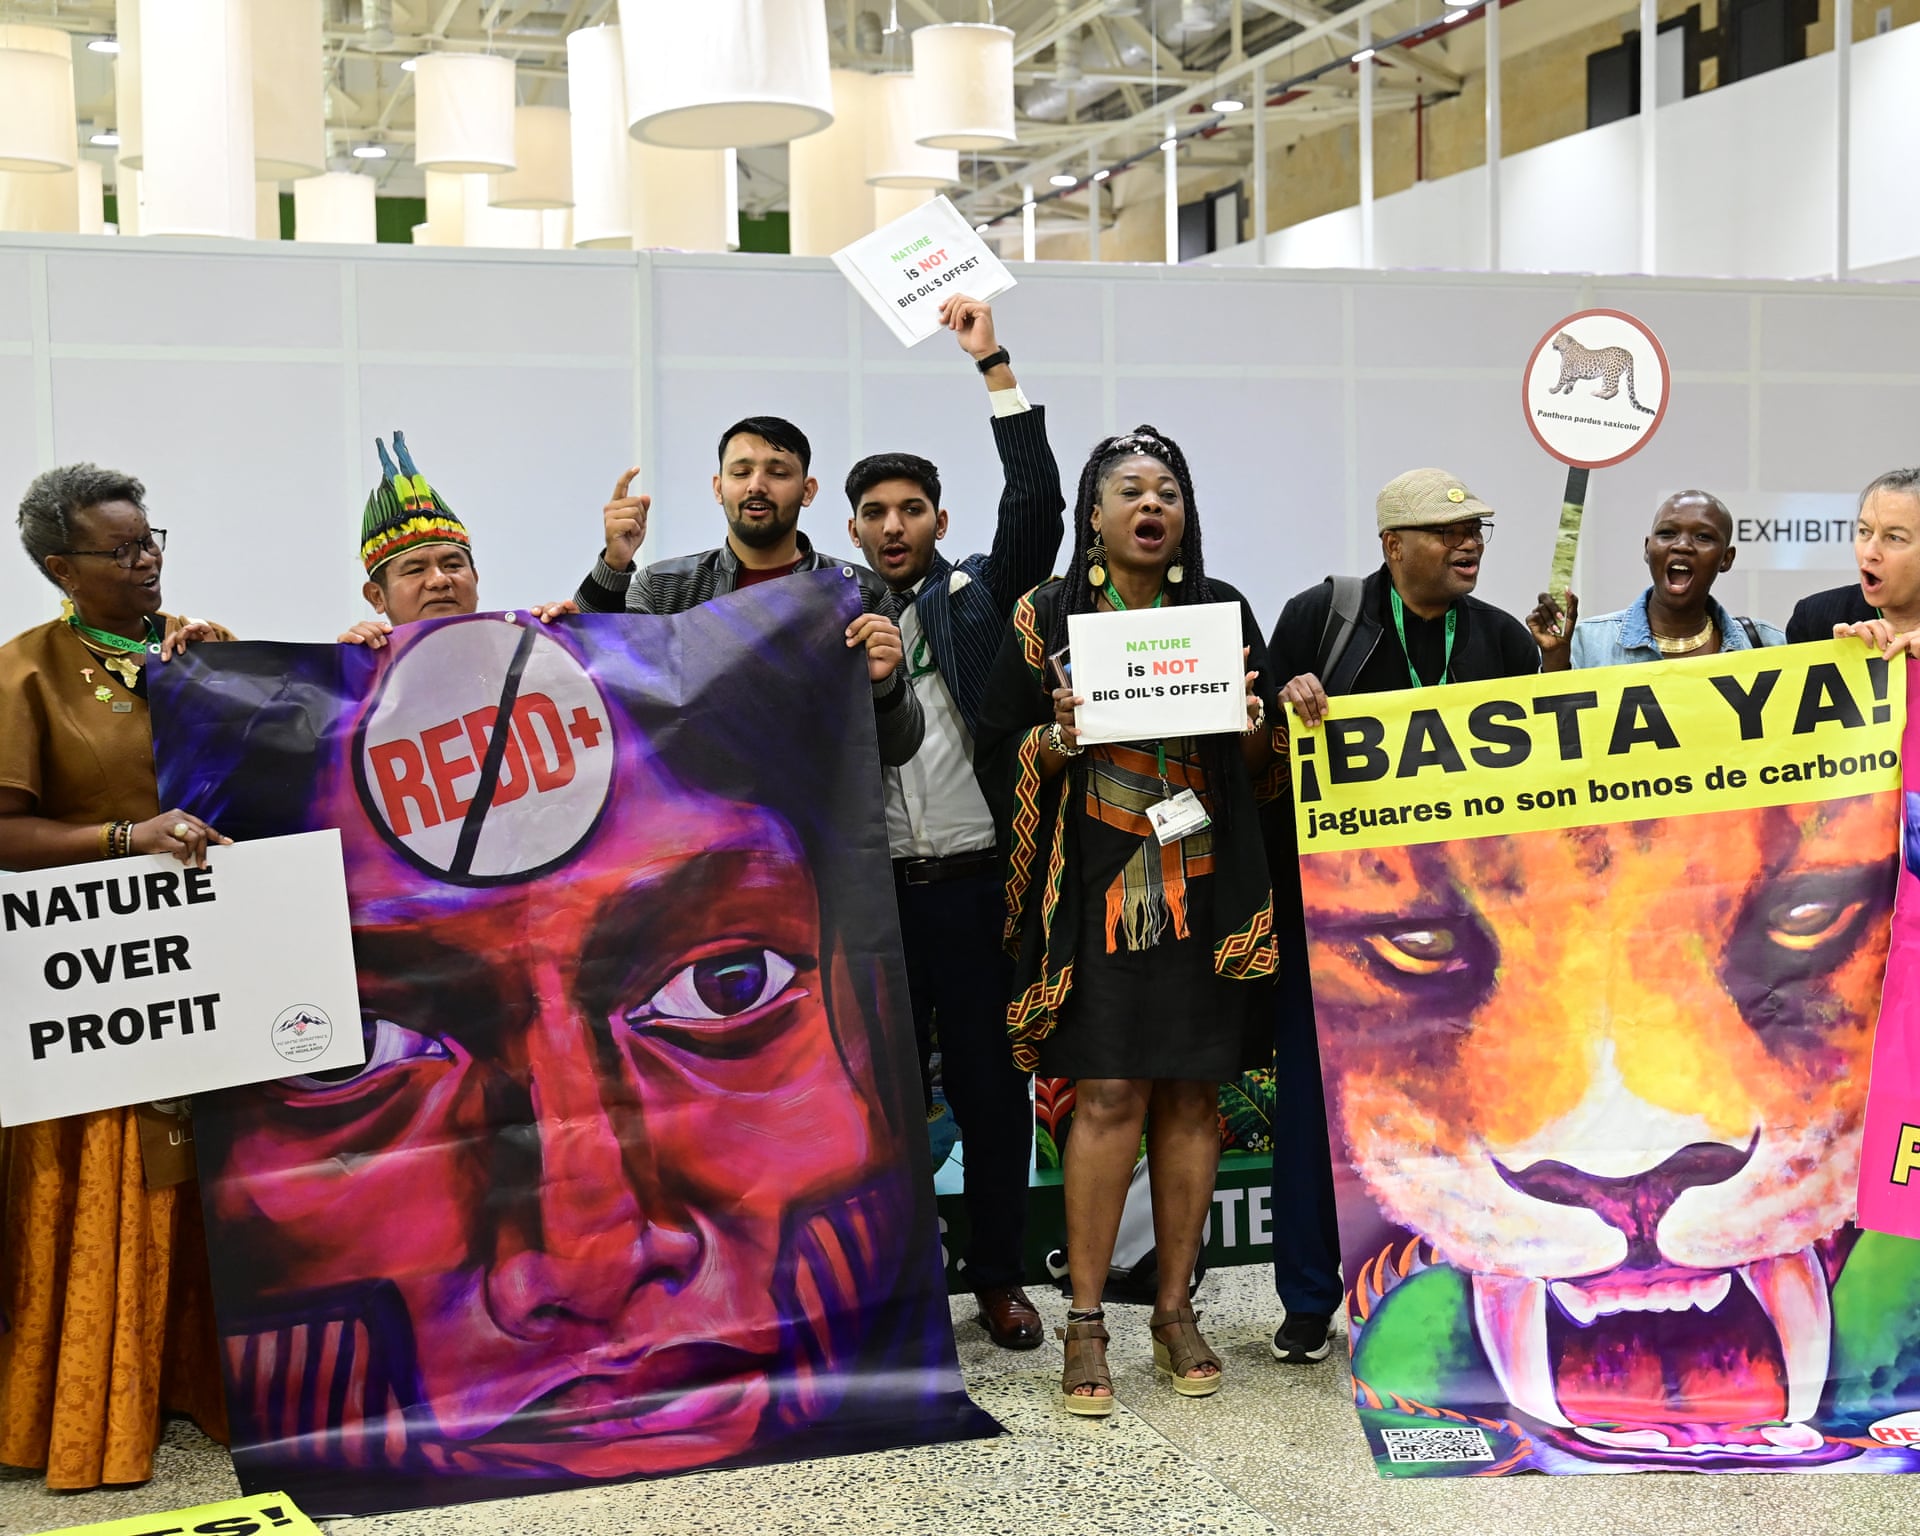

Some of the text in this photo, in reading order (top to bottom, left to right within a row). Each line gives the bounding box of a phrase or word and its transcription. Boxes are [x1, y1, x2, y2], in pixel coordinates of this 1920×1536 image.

[890, 235, 933, 263] NATURE
[903, 248, 949, 281] is NOT
[897, 256, 980, 308] BIG OIL'S OFFSET
[1537, 409, 1641, 431] Panthera pardus saxicolor
[1126, 637, 1191, 652] NATURE
[1127, 658, 1199, 677] is NOT
[1092, 682, 1230, 702] BIG OIL'S OFFSET
[1298, 657, 1890, 803] ¡BASTA YA!
[368, 691, 603, 837] REDD+
[1307, 747, 1897, 838] jaguares no son bonos de carbono
[2, 865, 217, 931] NATURE
[43, 935, 192, 990] OVER
[29, 993, 221, 1060] PROFIT
